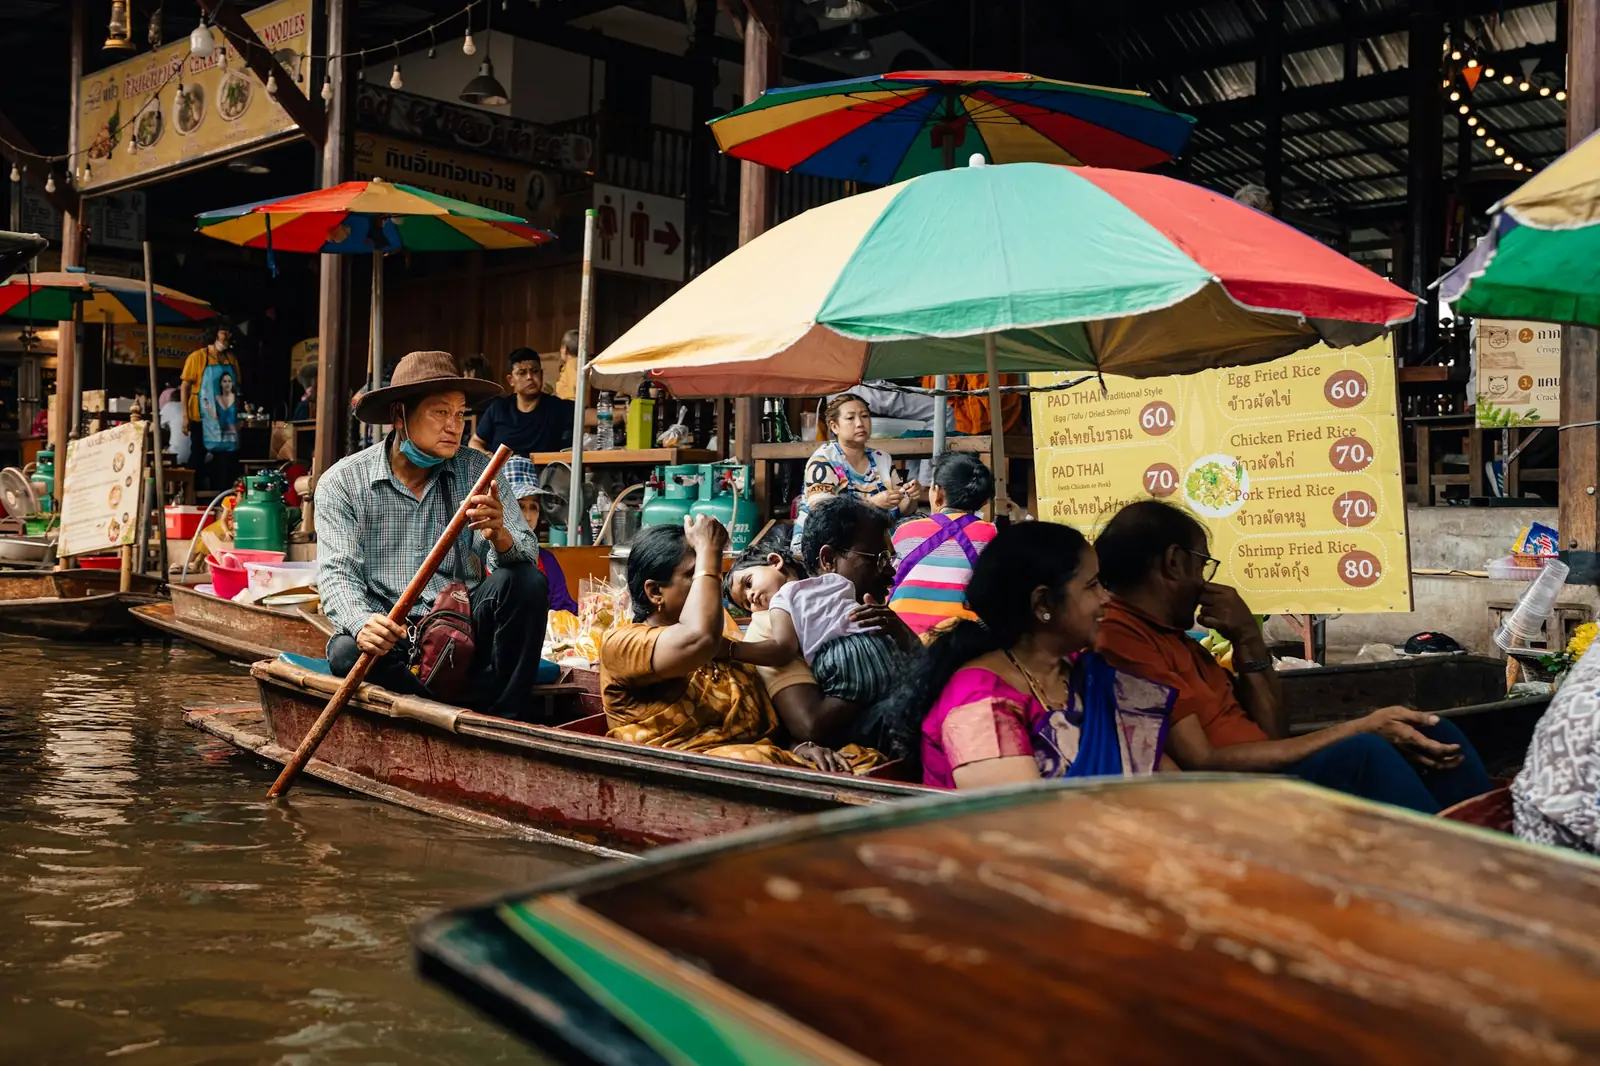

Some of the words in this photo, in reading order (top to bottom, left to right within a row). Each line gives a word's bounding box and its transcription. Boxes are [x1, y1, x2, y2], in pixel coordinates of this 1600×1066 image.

[264, 13, 305, 45] NOODLES
[385, 146, 516, 192] กินอิ่มก่อนจ่าย
[1536, 345, 1560, 354] Crispy
[1227, 373, 1251, 388] Egg
[1254, 368, 1288, 383] Fried
[1292, 364, 1321, 378] Rice
[1047, 393, 1070, 408] PAD
[1072, 389, 1101, 405] THAI
[1106, 389, 1142, 401] raditional
[1144, 387, 1163, 399] Style
[1227, 389, 1292, 411] ข้าวผัดไข่
[1536, 392, 1560, 401] Crack
[1053, 414, 1066, 423] (Egg
[1070, 413, 1084, 421] Tofu
[1089, 410, 1105, 418] Dried
[1106, 407, 1131, 416] Shrimp)
[1049, 425, 1133, 446] ผัดไทยโบราณ
[1230, 431, 1283, 448] Chicken
[1287, 428, 1322, 442] Fried
[1326, 425, 1357, 439] Rice
[1052, 464, 1074, 478] PAD
[1076, 462, 1104, 477] THAI
[1231, 451, 1295, 471] ข้าวผัดไก่
[1097, 480, 1111, 488] Pork)
[1234, 487, 1264, 501] Pork
[1267, 485, 1302, 499] Fried
[1306, 483, 1335, 497] Rice
[1237, 509, 1306, 528] ข้าวผัดหมู
[1237, 544, 1284, 560] Shrimp
[1288, 542, 1323, 556] Fried
[1328, 540, 1357, 554] Rice
[1243, 561, 1310, 583] ข้าวผัดกุ้ง
